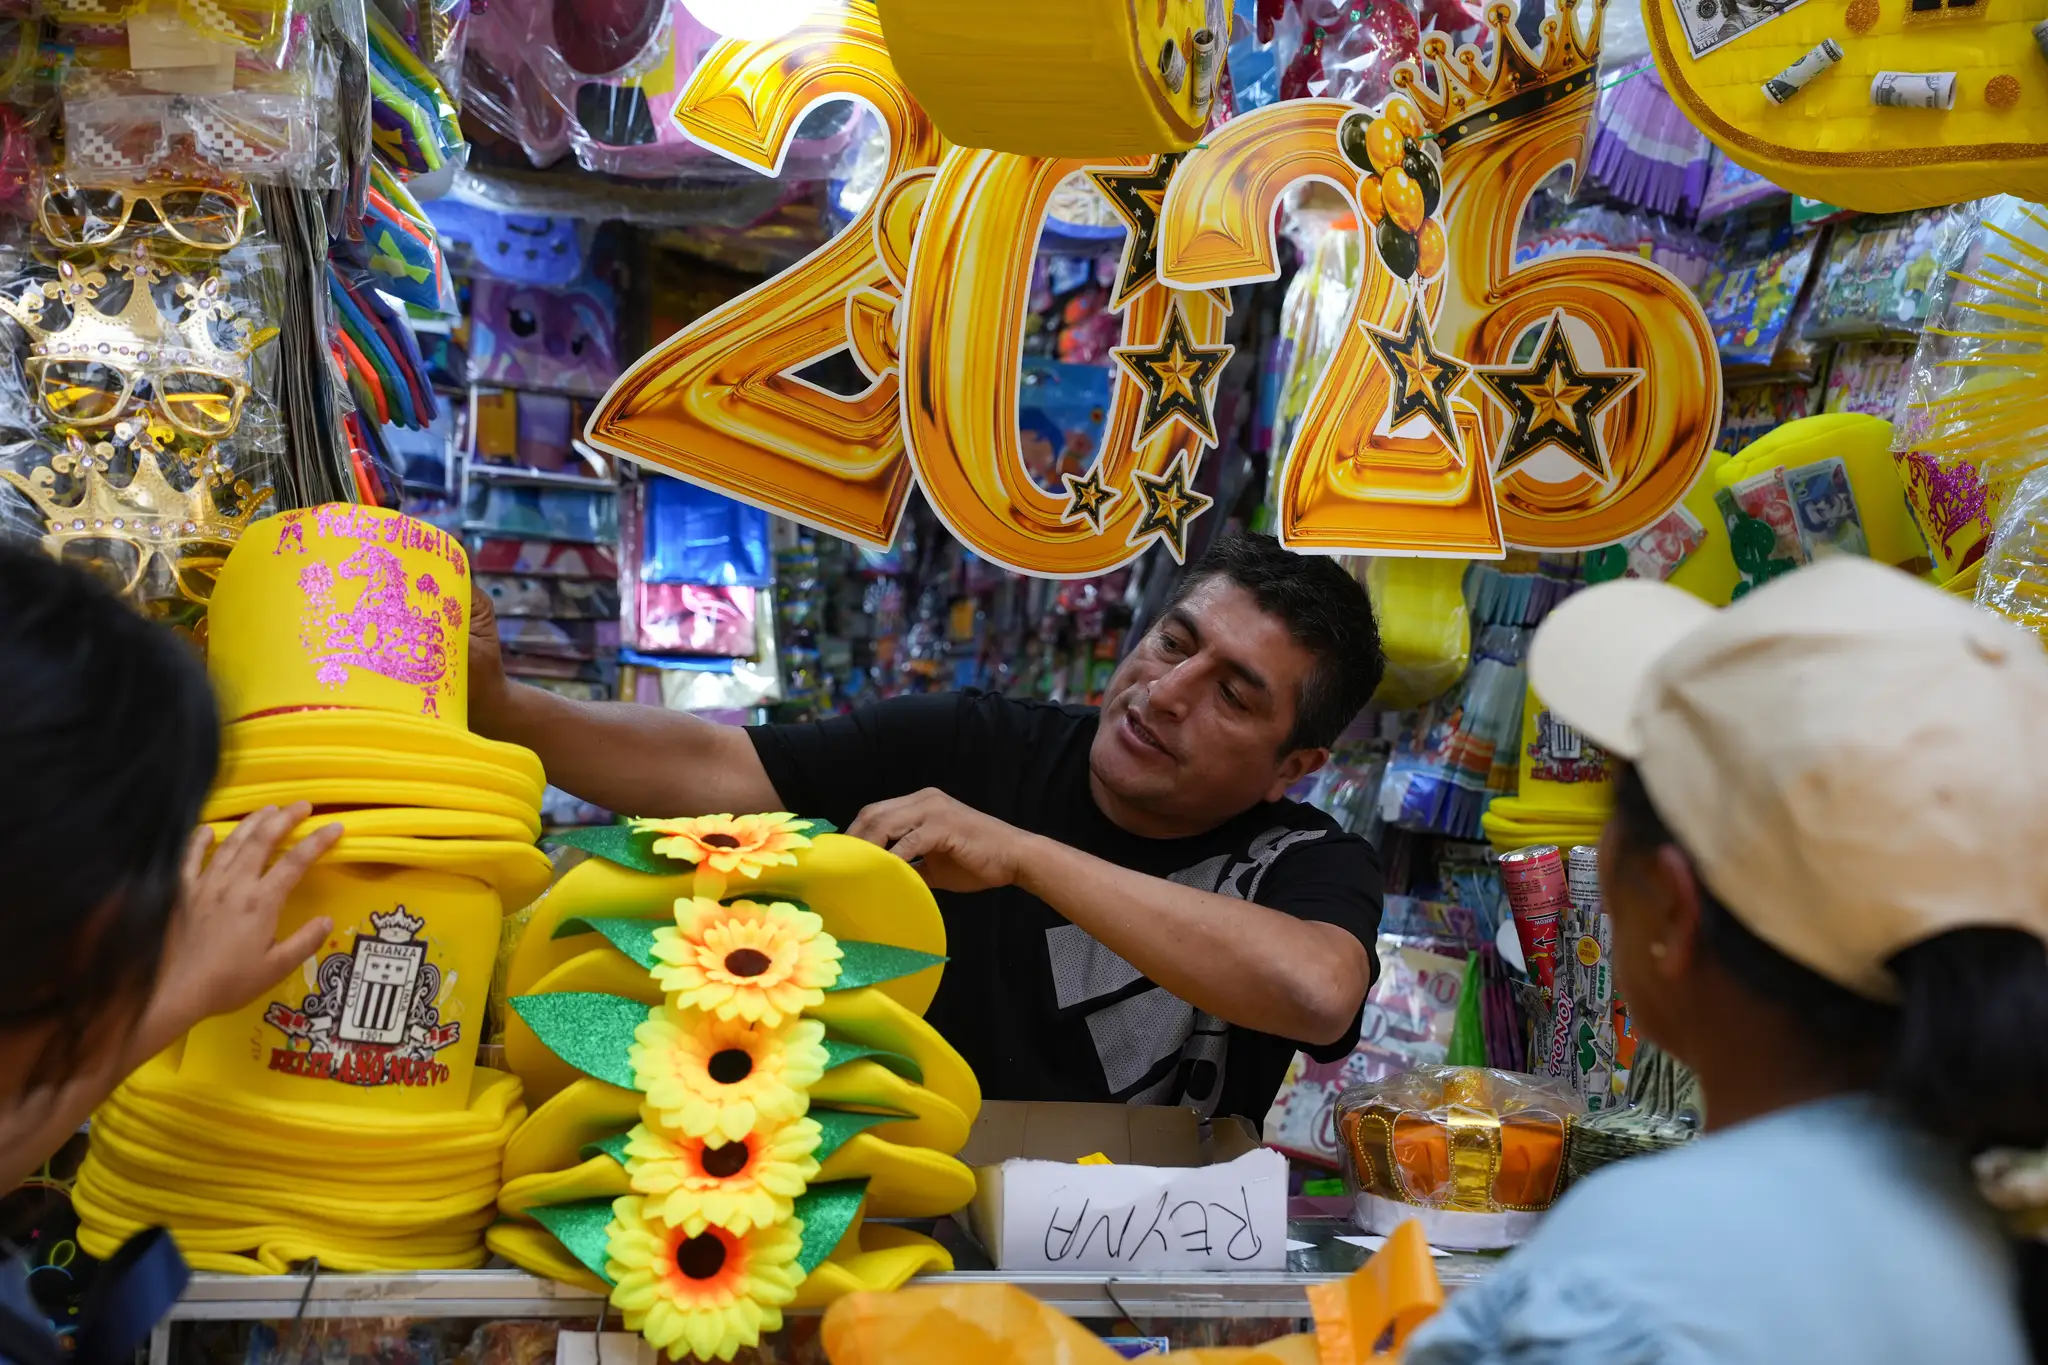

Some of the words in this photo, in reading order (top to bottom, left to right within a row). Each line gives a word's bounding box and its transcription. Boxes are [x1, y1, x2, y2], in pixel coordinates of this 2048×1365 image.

[312, 503, 381, 541] Feliz
[1534, 915, 1557, 928] ARROW
[363, 941, 417, 958] ALIANZA
[345, 970, 362, 1009] CLUB
[358, 1029, 385, 1042] 1901
[1548, 989, 1574, 1076] TONO!
[268, 1047, 334, 1079] FELIZ
[335, 1049, 384, 1085] AÑO
[386, 1055, 450, 1087] NUEVO
[1044, 1185, 1263, 1262] REYNA
